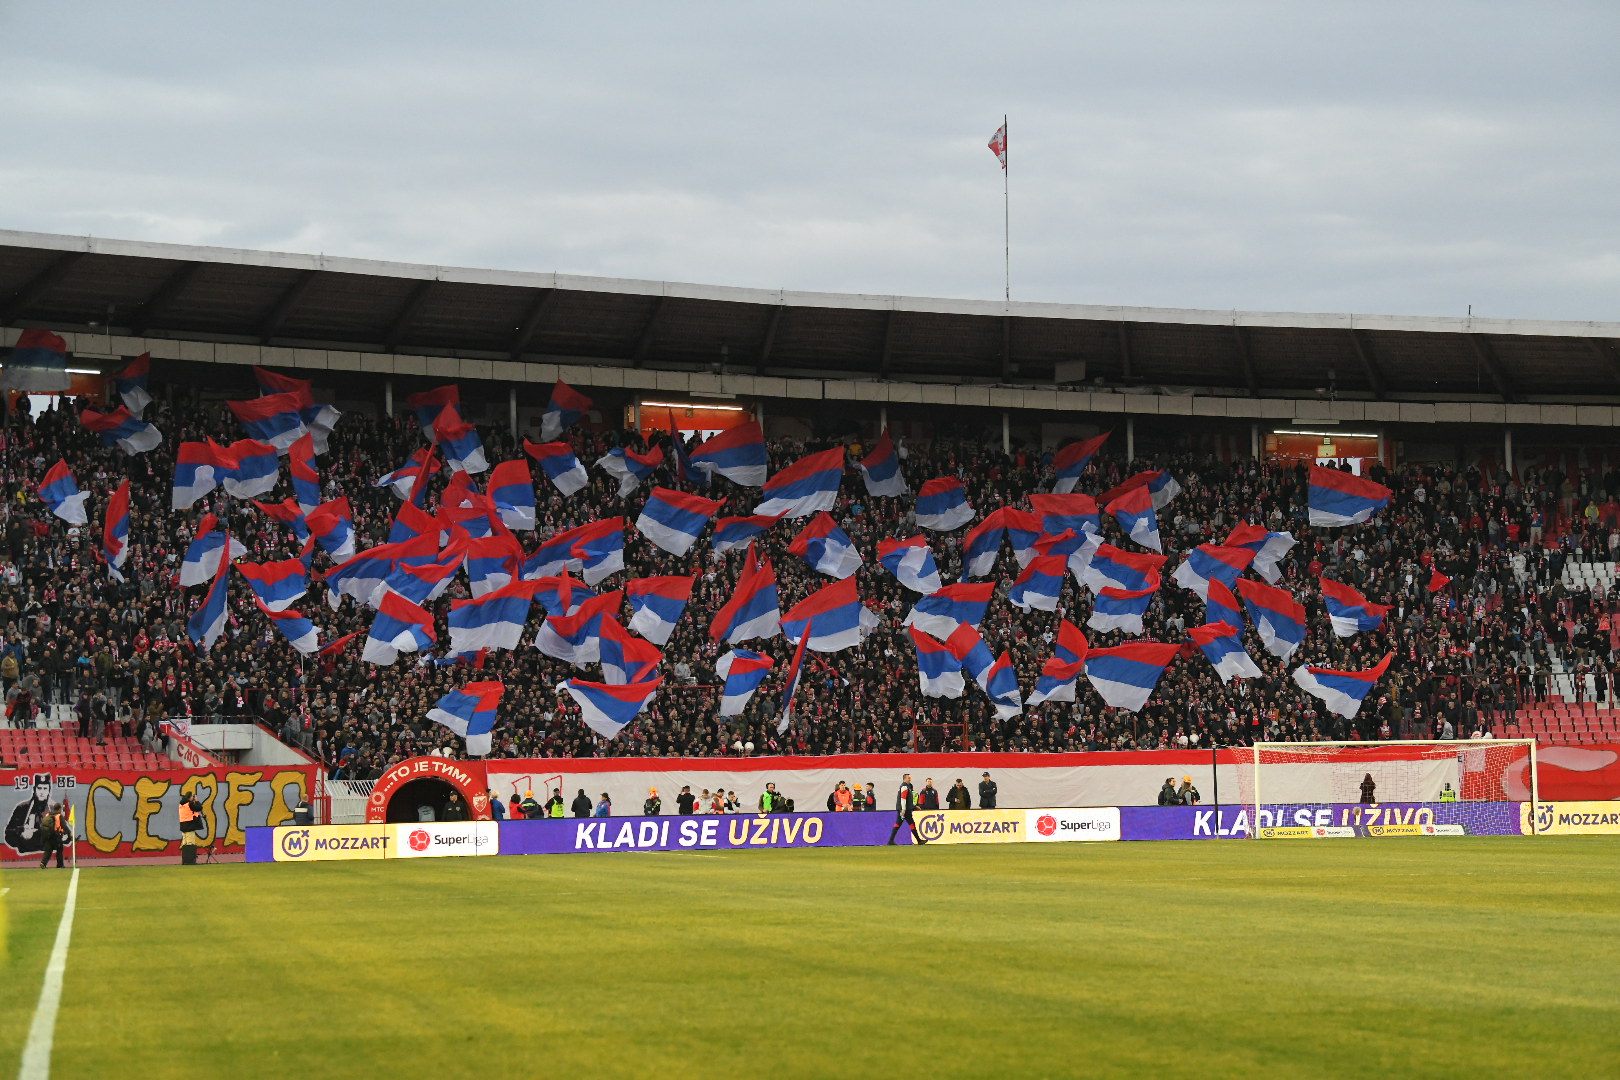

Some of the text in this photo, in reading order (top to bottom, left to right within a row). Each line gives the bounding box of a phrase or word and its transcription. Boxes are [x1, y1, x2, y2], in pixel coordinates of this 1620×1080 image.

[413, 761, 429, 773] ЈЕ
[431, 761, 472, 787] ТИМ!
[57, 775, 75, 788] 86
[1060, 819, 1111, 832] SuperLiga
[1558, 813, 1620, 826] MOZZAR
[575, 813, 824, 849] KLADI SE UŽIVO
[949, 821, 1020, 834] MOZZART
[314, 836, 391, 851] MOZZART
[434, 833, 489, 847] SuperLiga
